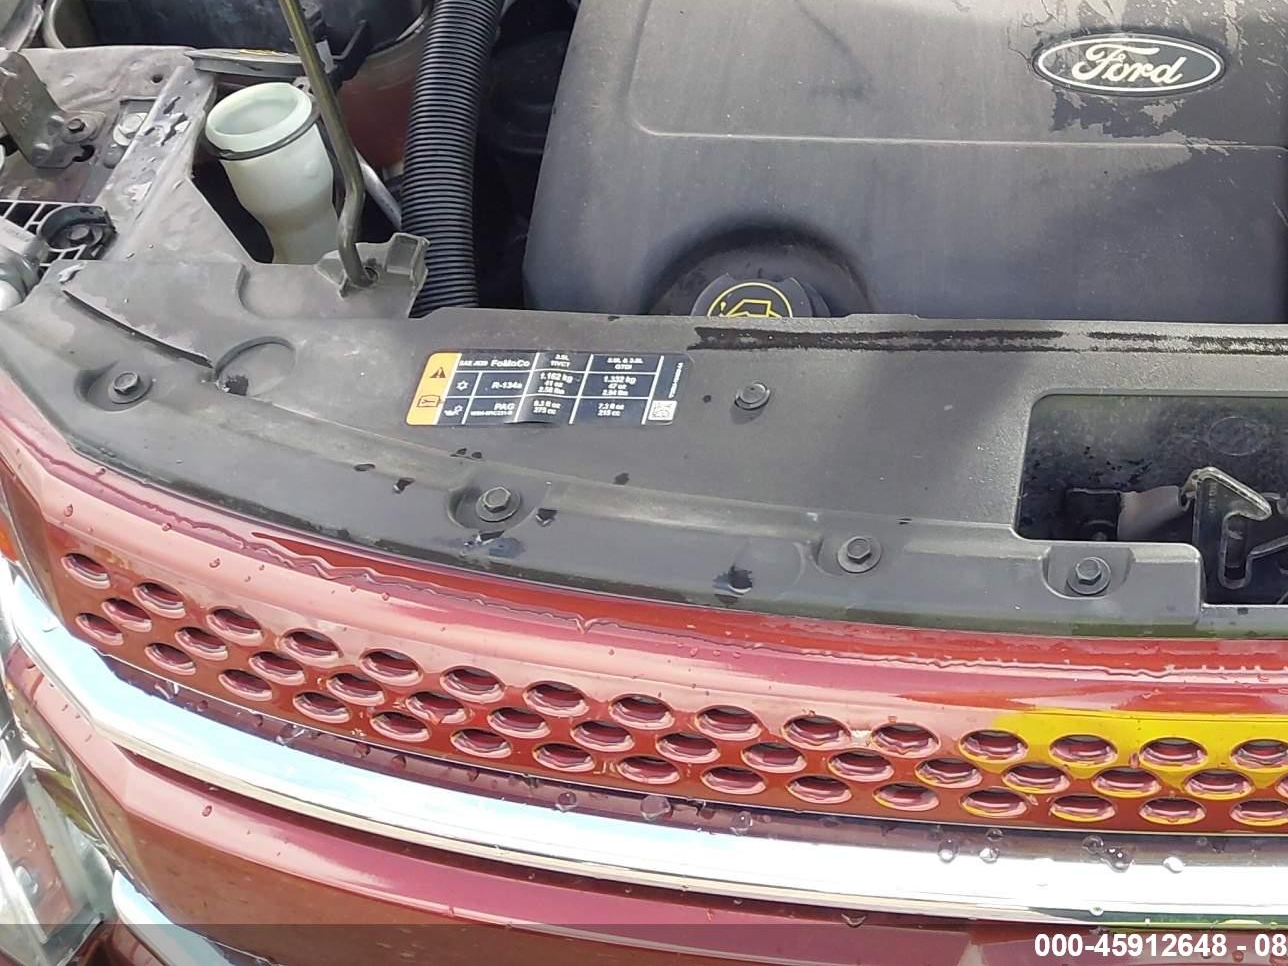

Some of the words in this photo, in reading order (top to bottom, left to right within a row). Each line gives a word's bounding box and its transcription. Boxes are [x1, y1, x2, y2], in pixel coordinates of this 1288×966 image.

[1071, 43, 1187, 84] Ford
[490, 358, 530, 368] FoMoCo
[561, 373, 574, 384] kg
[625, 375, 637, 385] kg
[491, 381, 523, 390] R-134a
[494, 402, 516, 412] PAG
